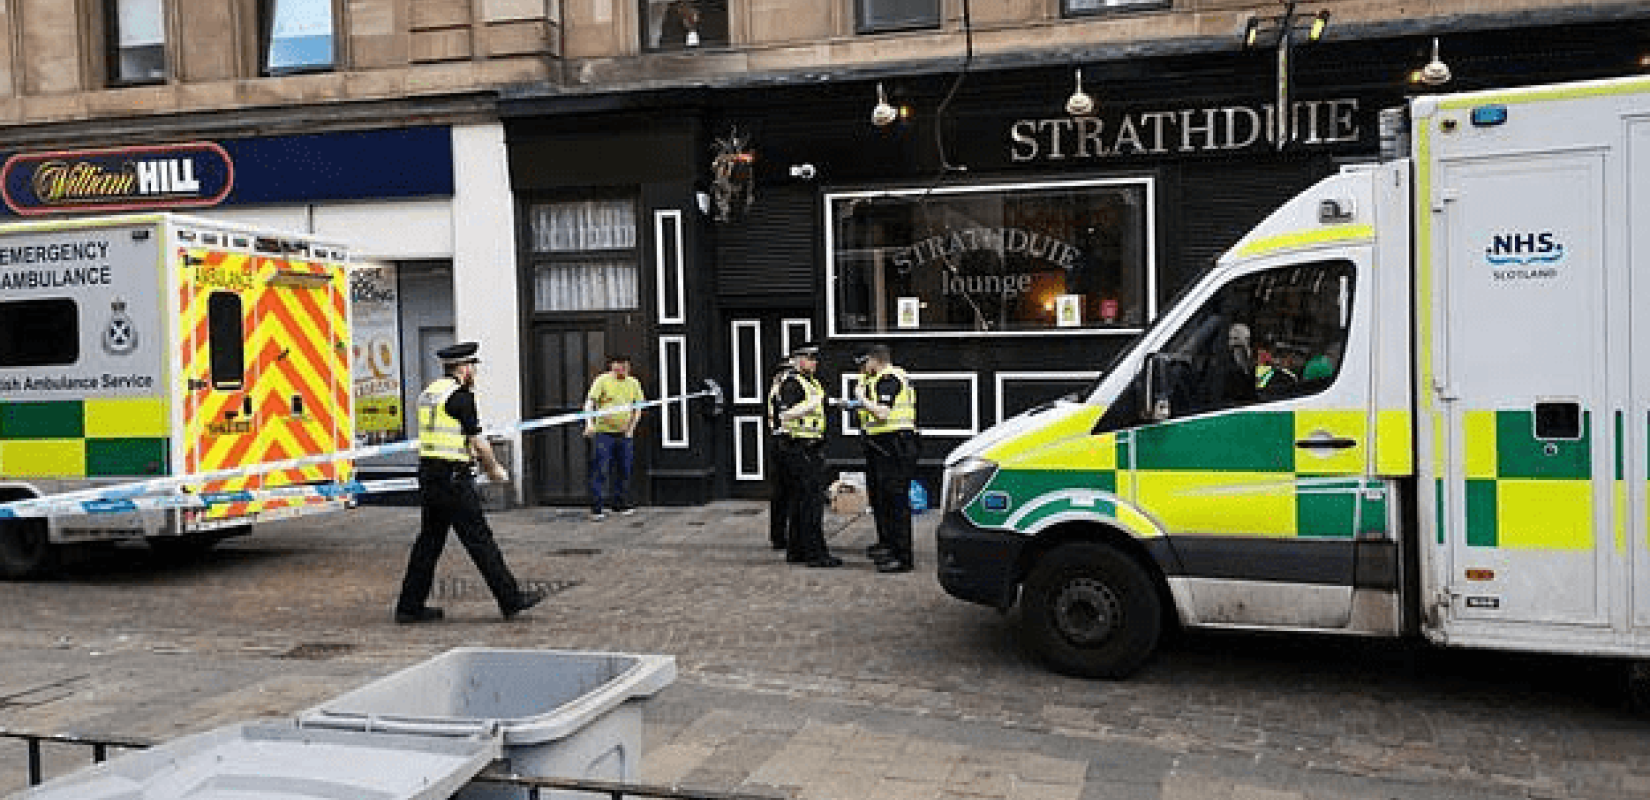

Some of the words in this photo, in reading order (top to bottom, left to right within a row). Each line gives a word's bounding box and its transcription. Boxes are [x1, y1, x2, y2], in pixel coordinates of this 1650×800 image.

[1010, 98, 1360, 162] STRATHDUIE
[34, 161, 136, 201] William
[137, 157, 200, 193] HILL
[0, 240, 109, 265] EMERGENCY
[892, 226, 1082, 275] STRATHDUIE
[1493, 232, 1553, 254] NHS
[1, 264, 112, 290] AMBULANCE
[942, 270, 1031, 299] lounge
[1493, 267, 1558, 280] SCOTLAND
[23, 375, 99, 391] Ambulance
[101, 373, 153, 388] Service
